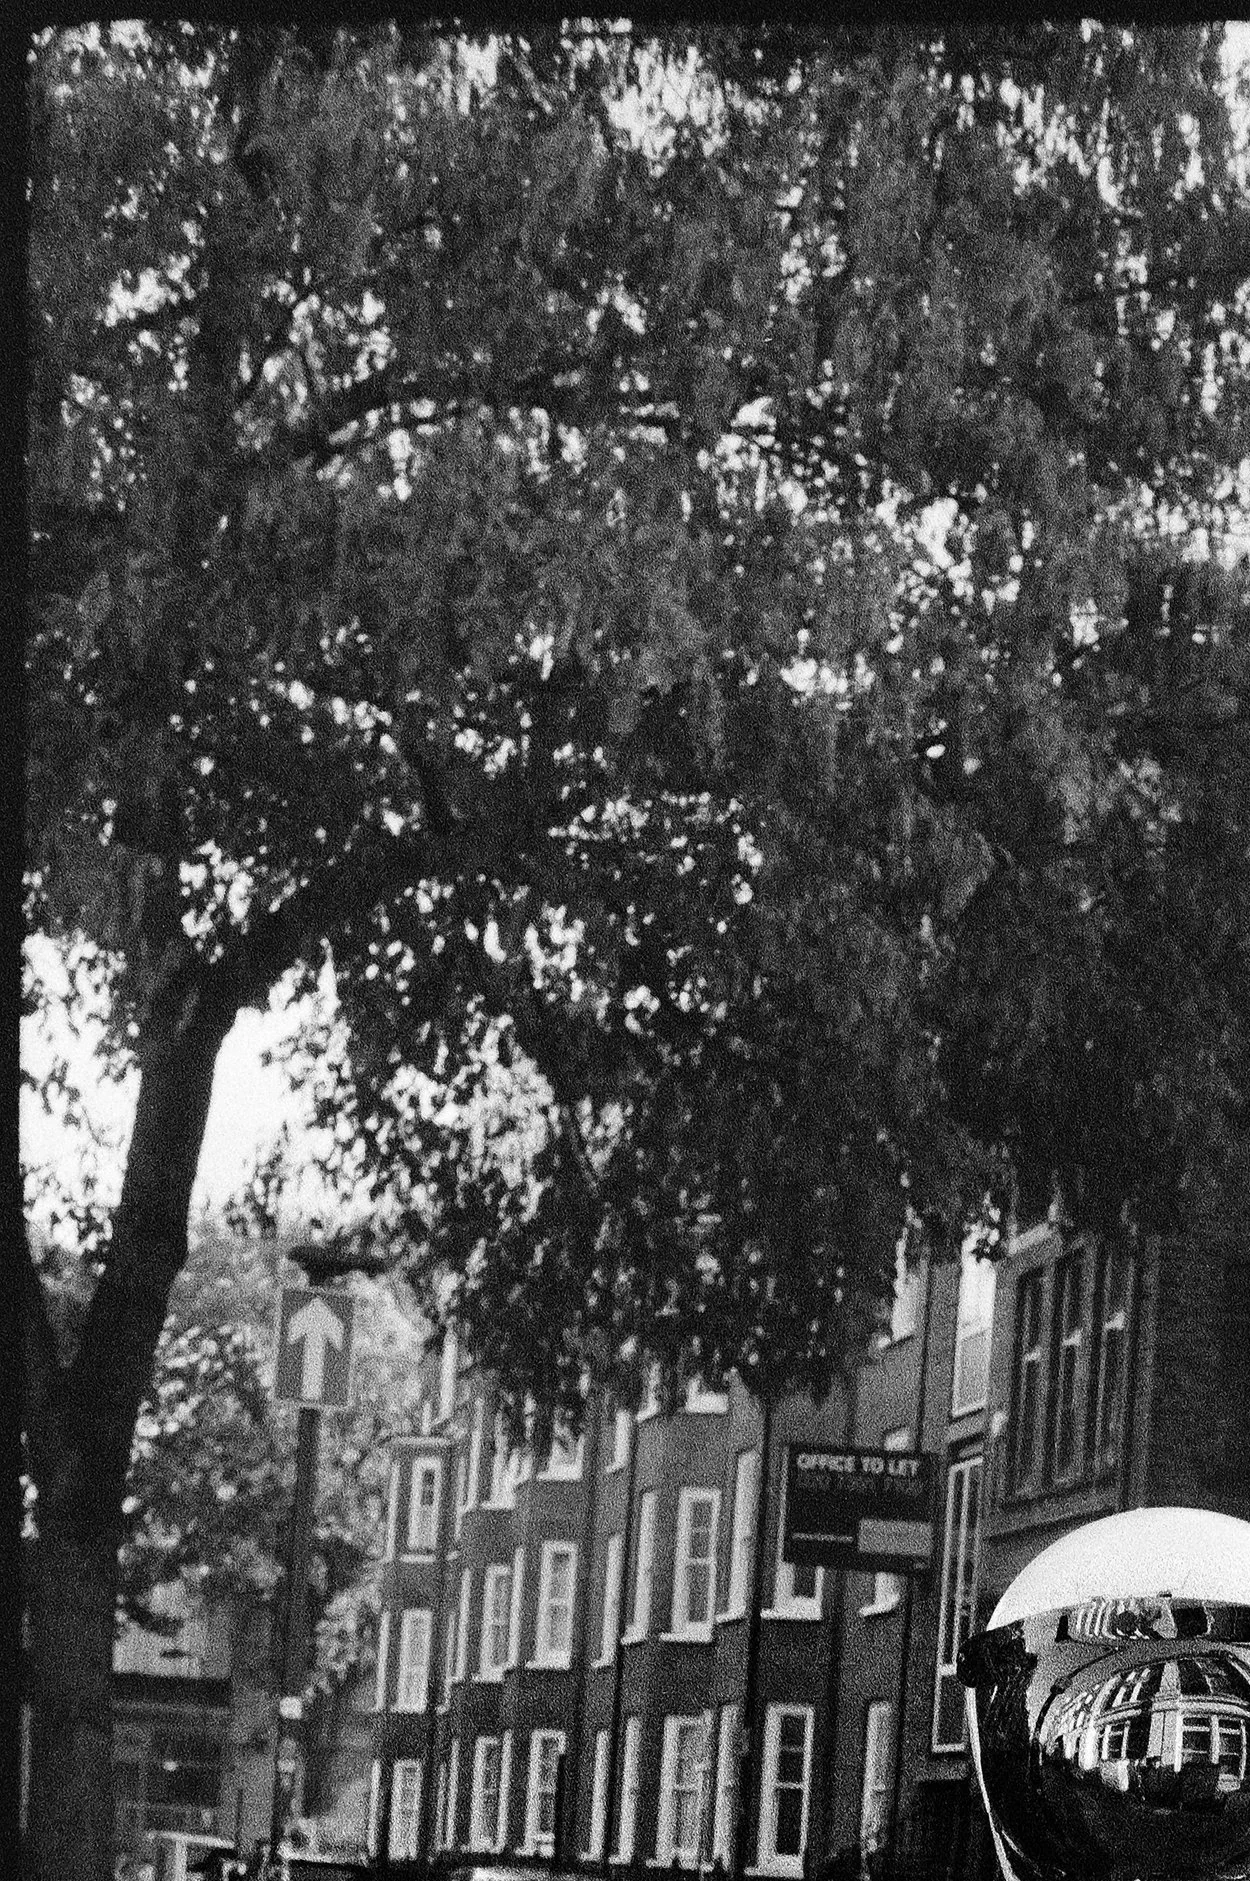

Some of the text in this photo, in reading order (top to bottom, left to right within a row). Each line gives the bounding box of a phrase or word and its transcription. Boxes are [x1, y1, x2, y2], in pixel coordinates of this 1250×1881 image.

[797, 1452, 920, 1477] OFFICE TO LET
